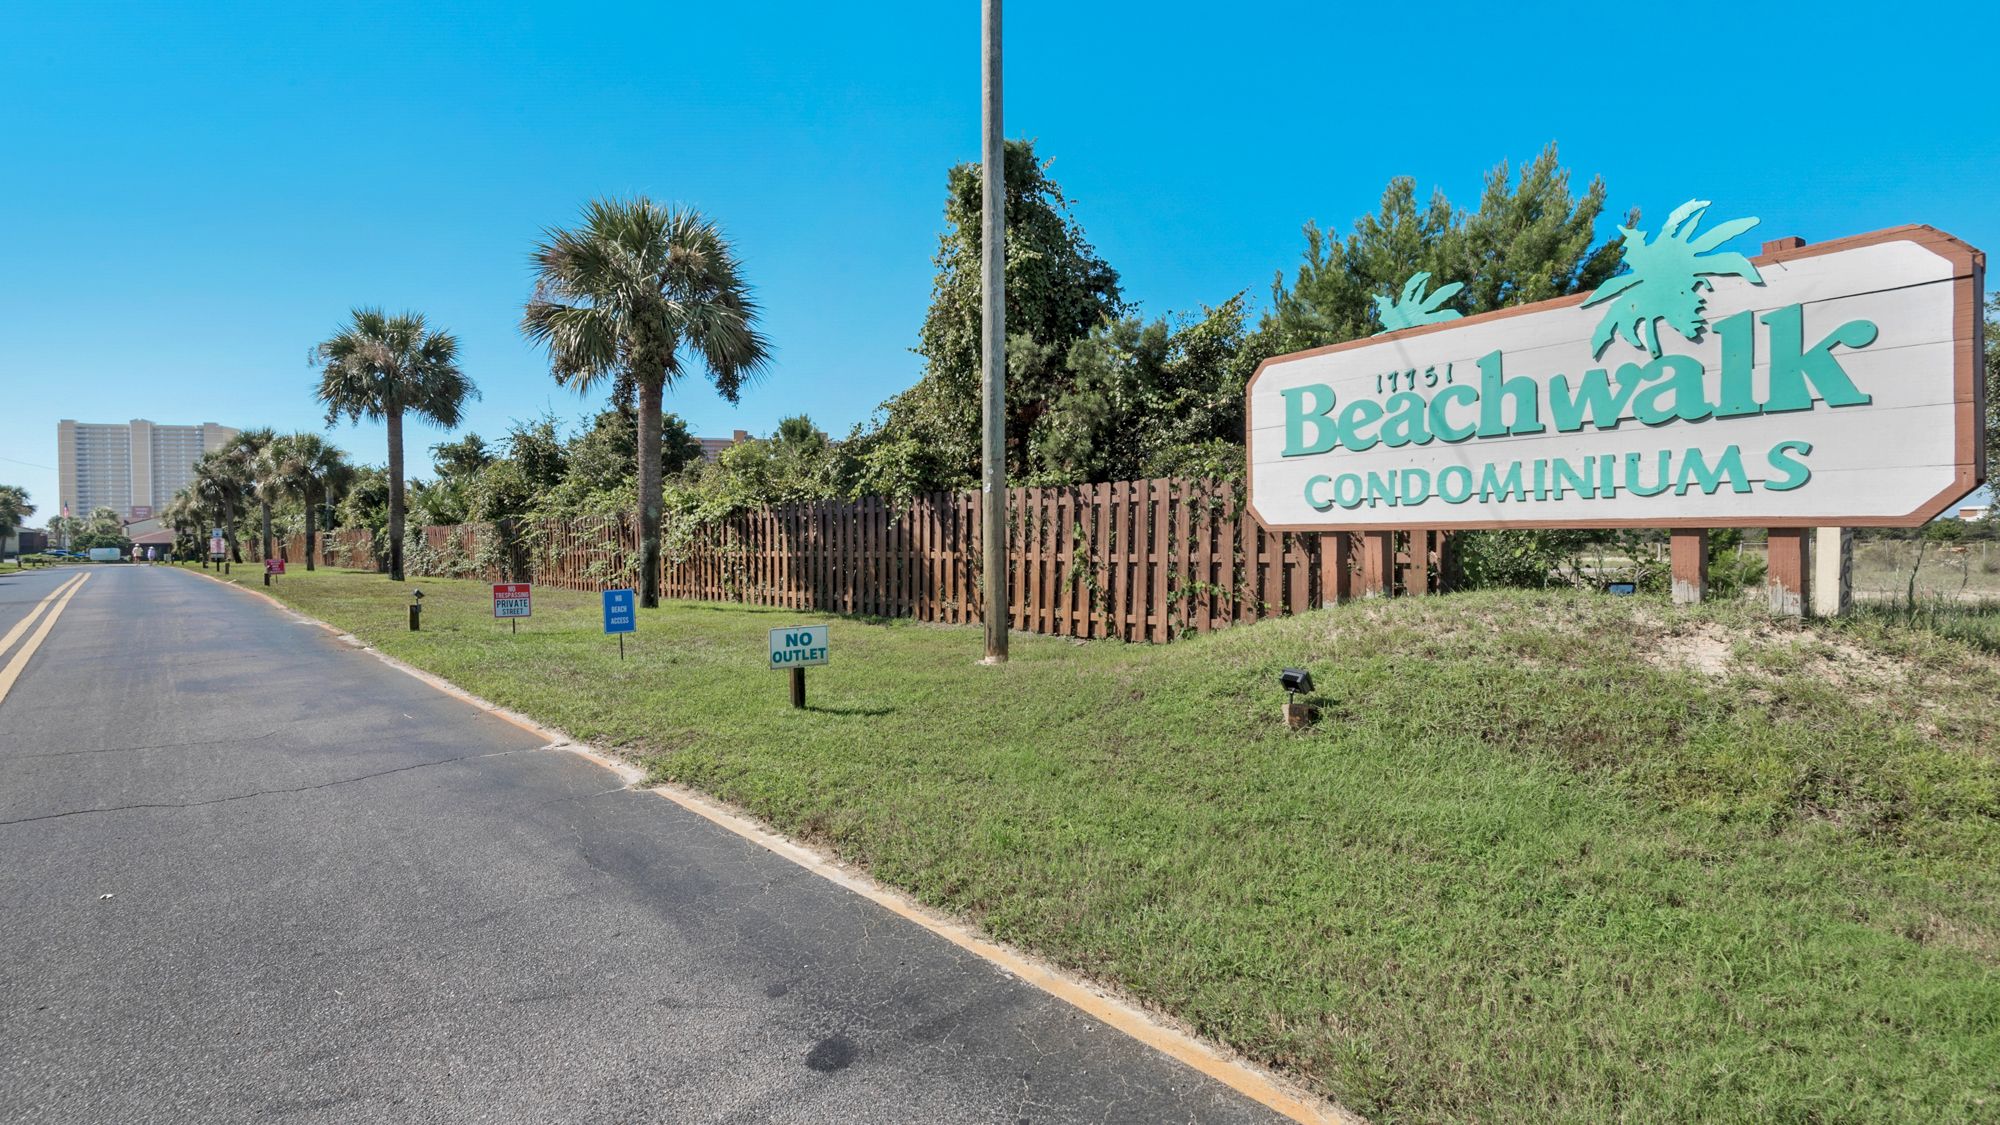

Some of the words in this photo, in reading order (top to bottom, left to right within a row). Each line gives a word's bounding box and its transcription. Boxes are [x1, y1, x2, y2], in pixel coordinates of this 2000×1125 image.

[1280, 303, 1878, 457] Beachwalk
[1375, 363, 1453, 394] 17751
[1304, 441, 1812, 509] CONDOMINIUMS
[497, 599, 528, 608] PRIVATE
[611, 605, 627, 613] BEACH
[610, 616, 629, 625] ACCESS
[786, 632, 812, 647] NO
[772, 648, 826, 663] OUTLET
